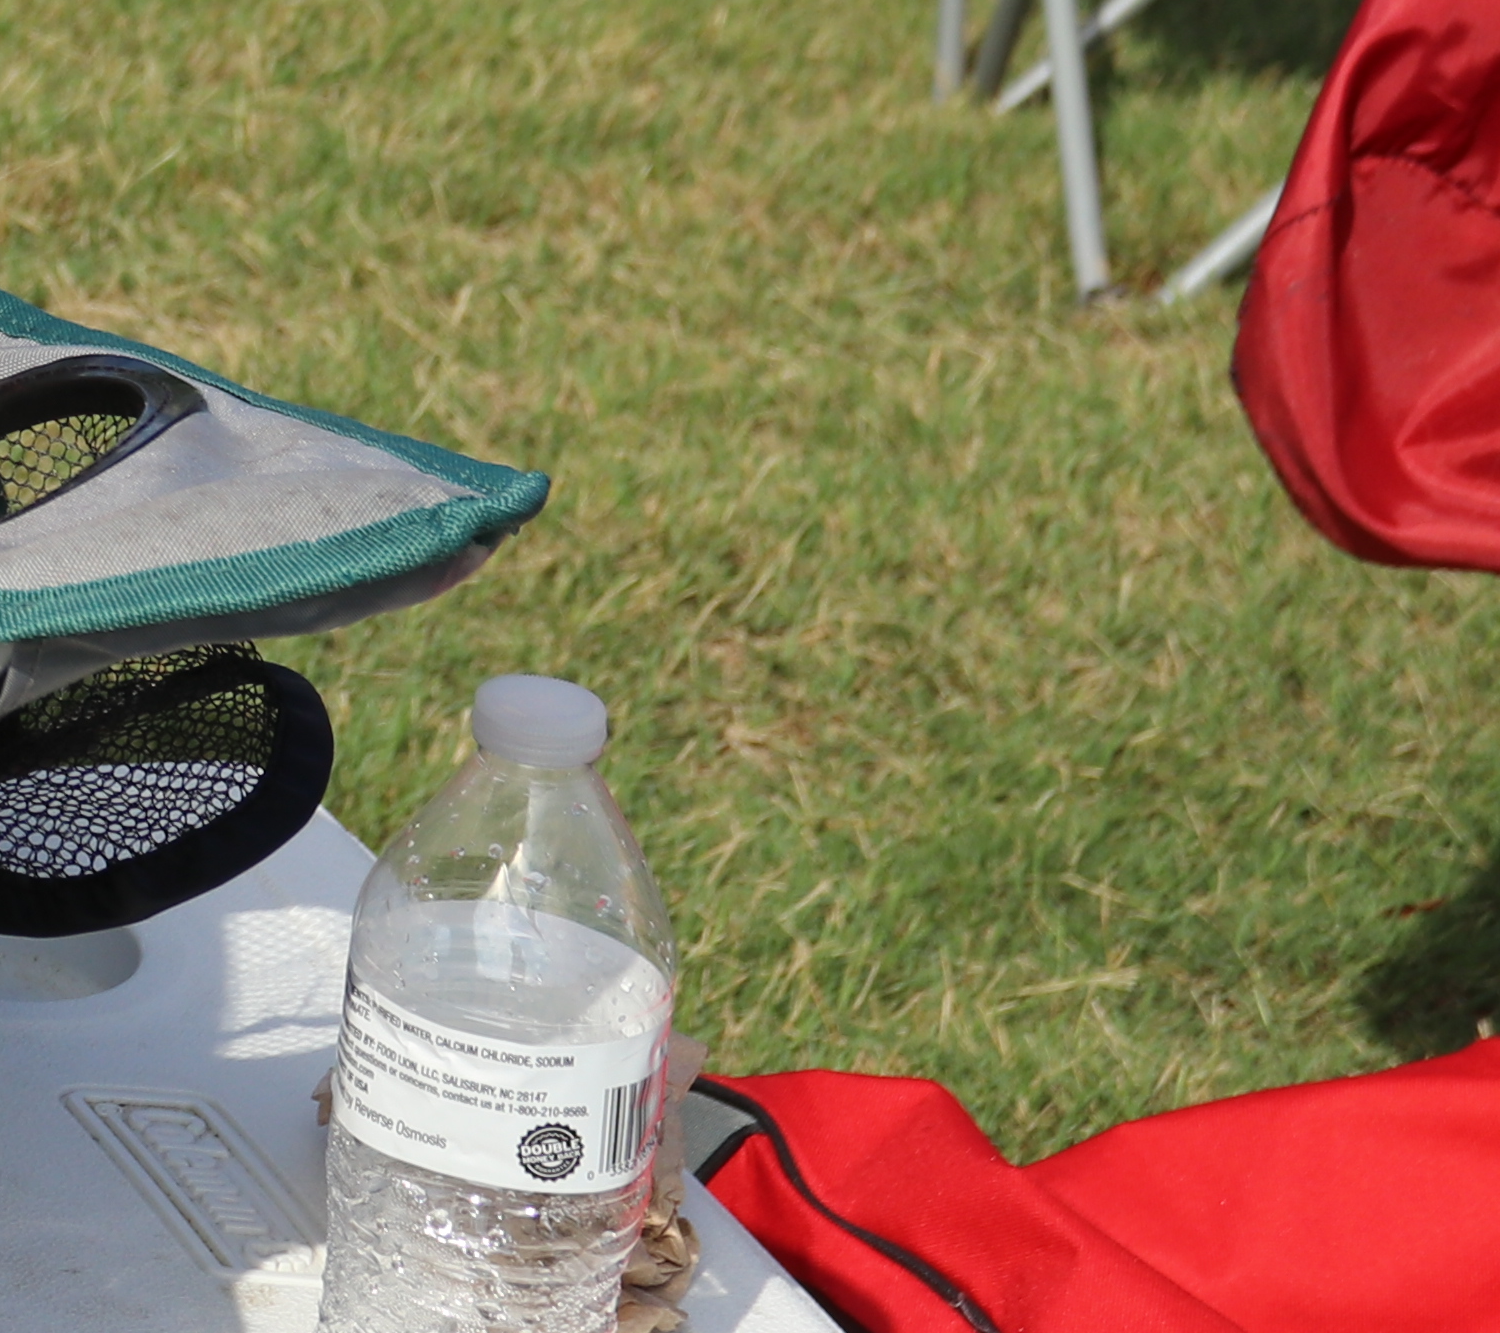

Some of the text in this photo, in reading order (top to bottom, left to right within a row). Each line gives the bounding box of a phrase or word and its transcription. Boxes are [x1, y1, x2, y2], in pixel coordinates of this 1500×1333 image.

[402, 1020, 434, 1045] WATER,
[435, 1034, 479, 1056] CALCIUM
[481, 1047, 533, 1068] CHLORIDE,
[536, 1056, 574, 1067] SODIUM
[354, 1077, 368, 1093] USA
[376, 1041, 397, 1062] FOOD
[398, 1054, 419, 1075] LION,
[421, 1065, 440, 1083] LLC,
[442, 1072, 497, 1098] SALISBURY,
[500, 1087, 514, 1100] NC
[517, 1091, 548, 1103] 28147
[399, 1072, 440, 1097] concerns,
[442, 1090, 478, 1107] contact
[481, 1099, 492, 1110] us
[495, 1101, 505, 1112] at
[354, 1097, 394, 1130] Reverse
[396, 1120, 447, 1149] Osmosis
[521, 1138, 581, 1157] DOUBLE
[522, 1154, 555, 1164] MONEY
